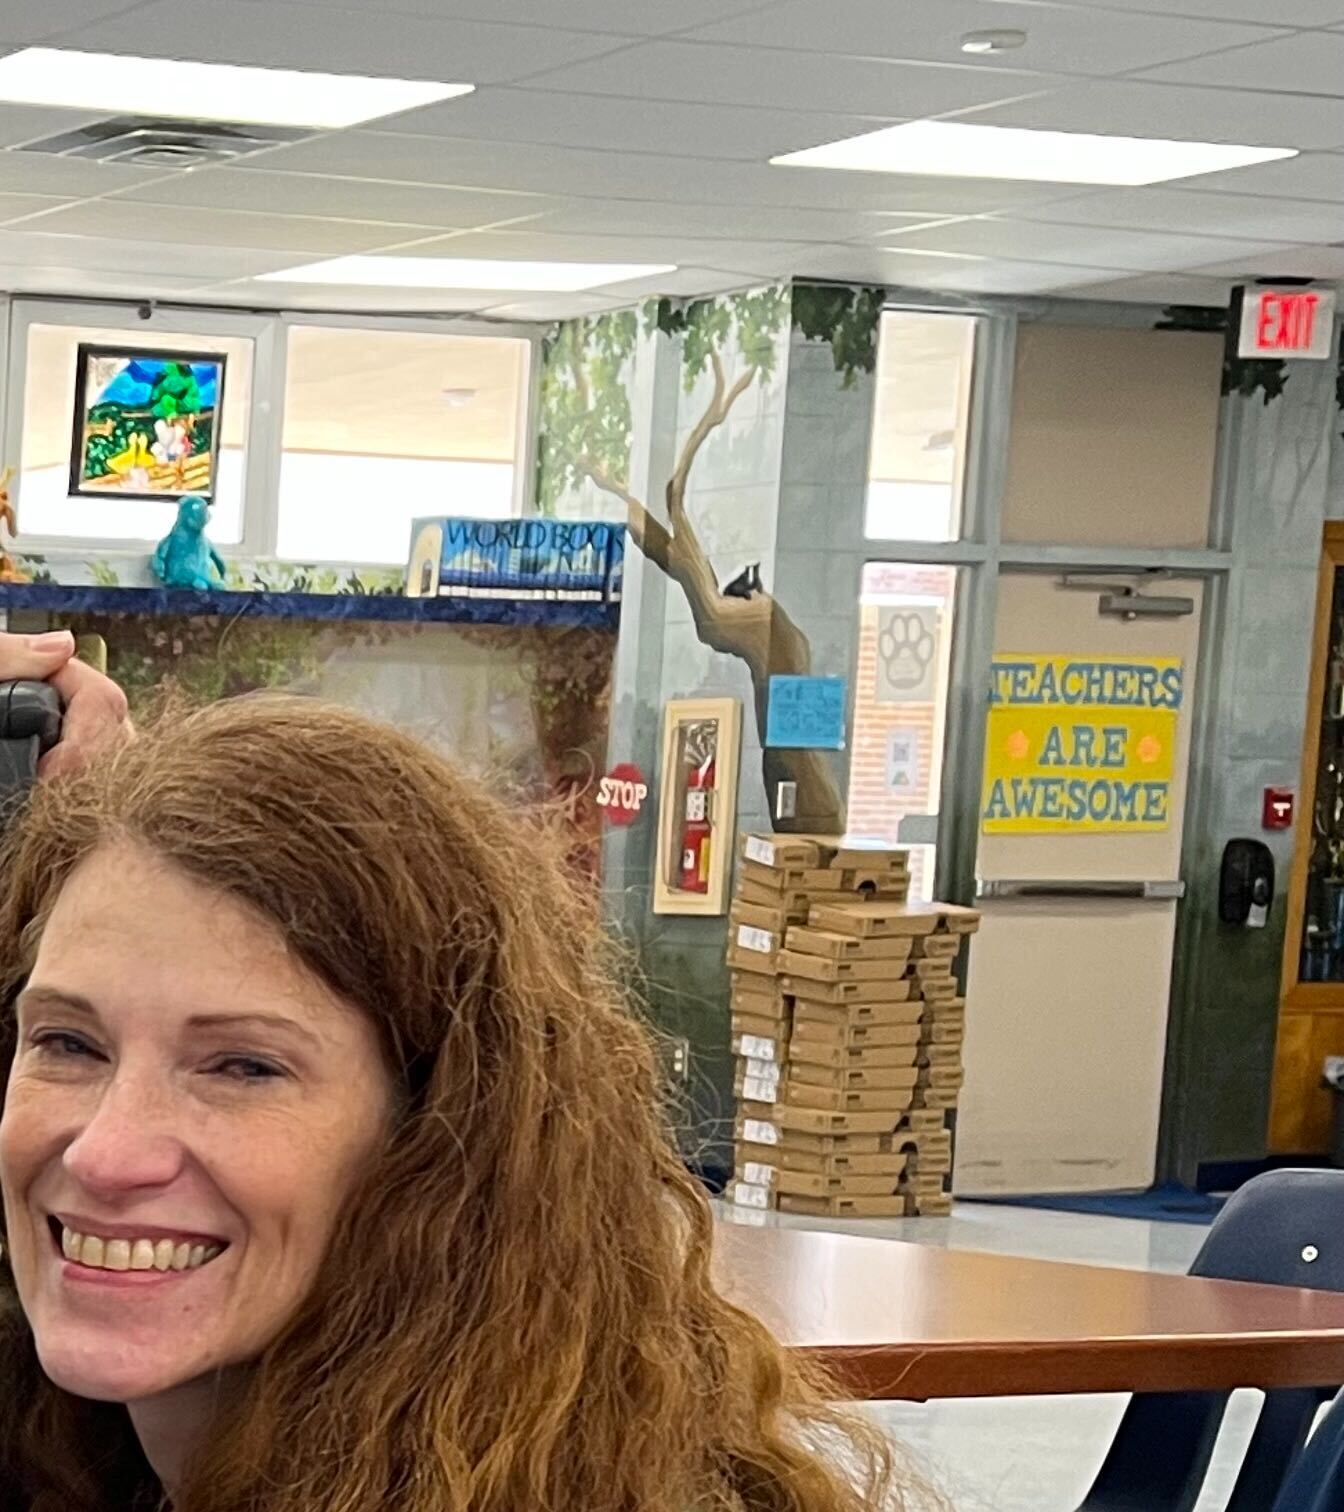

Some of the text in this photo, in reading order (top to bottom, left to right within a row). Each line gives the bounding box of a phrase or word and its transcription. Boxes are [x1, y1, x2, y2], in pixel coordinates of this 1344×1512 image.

[1256, 292, 1318, 350] EXIT
[445, 519, 547, 549] WORLD
[988, 662, 1185, 708] TEACHERS
[1038, 725, 1128, 768] ARE
[596, 776, 648, 811] STOP
[983, 778, 1170, 822] AWESOME
